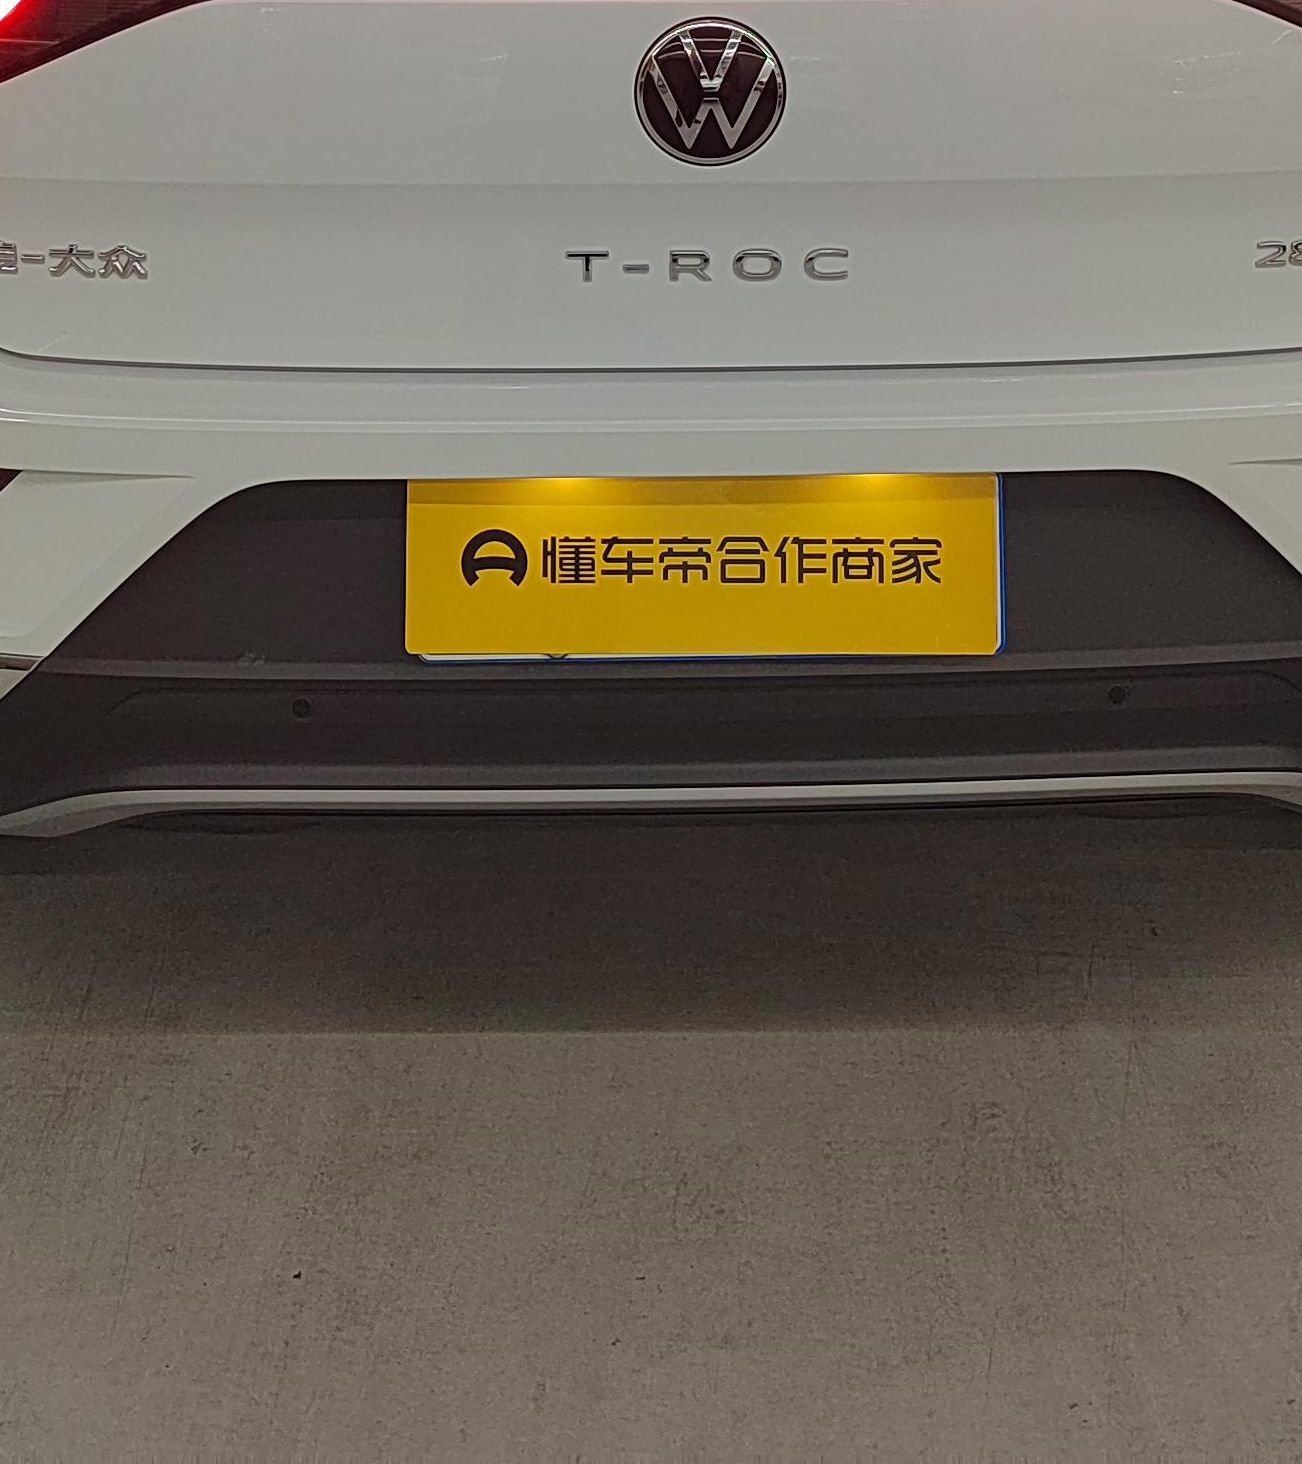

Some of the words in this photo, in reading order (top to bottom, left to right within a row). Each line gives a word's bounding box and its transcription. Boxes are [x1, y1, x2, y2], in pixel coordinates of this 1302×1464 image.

[645, 24, 779, 154] VW
[565, 248, 849, 282] T-ROC
[541, 536, 943, 585] 懂车帝合作商家
